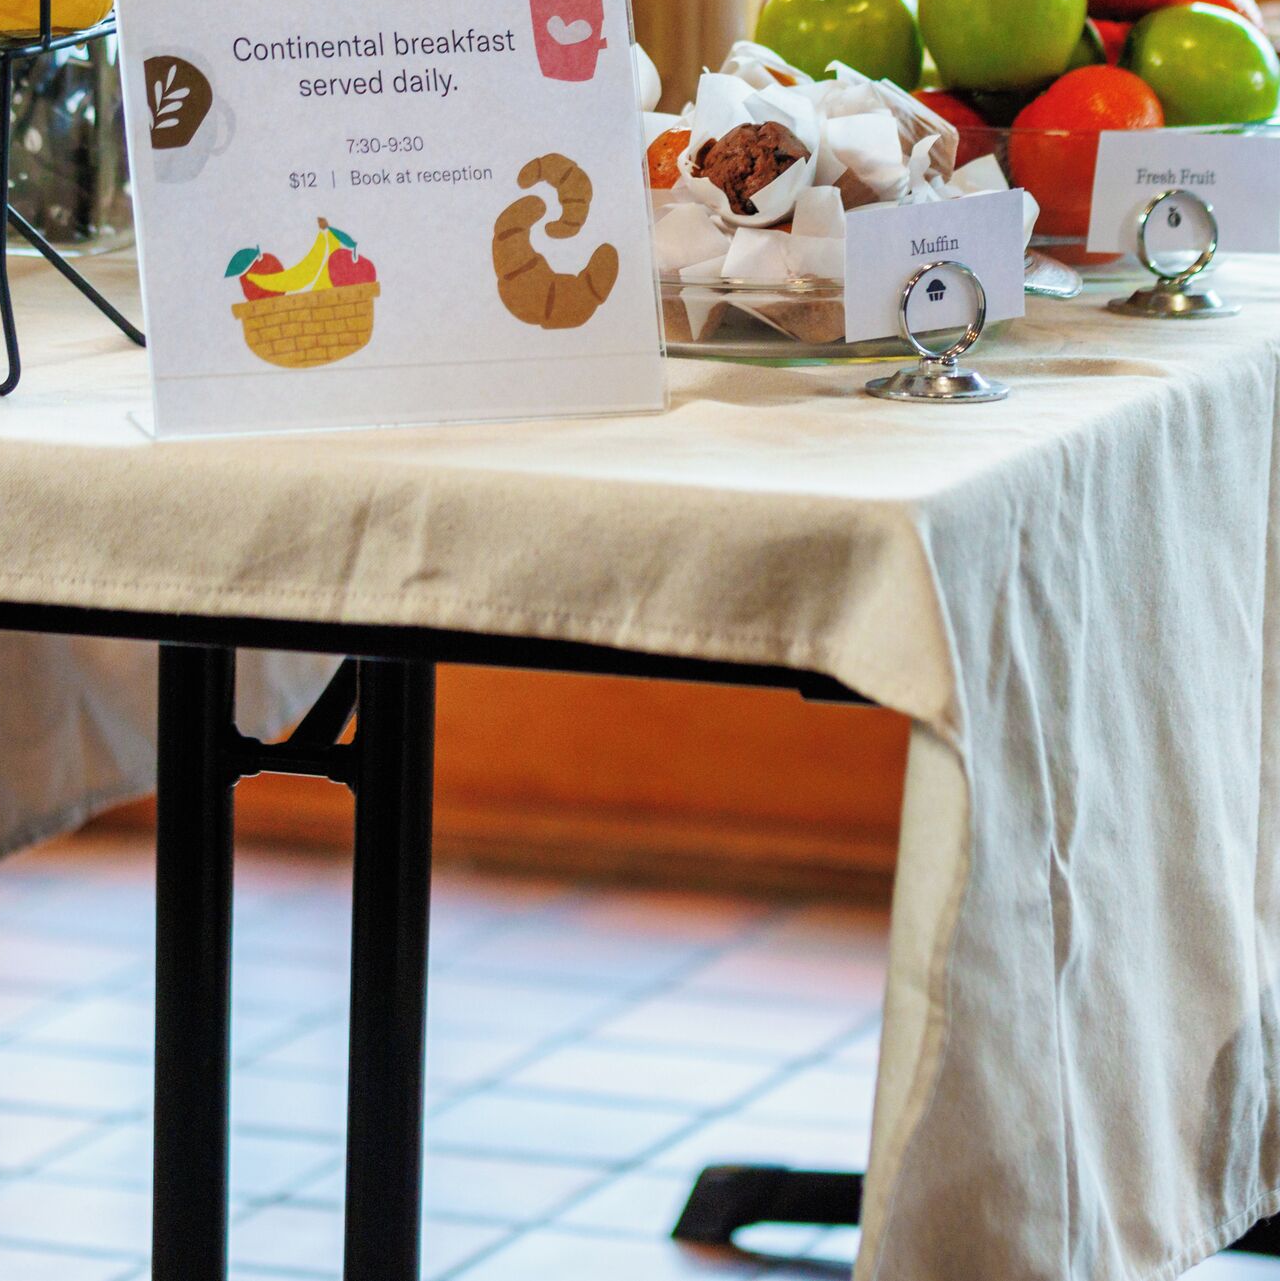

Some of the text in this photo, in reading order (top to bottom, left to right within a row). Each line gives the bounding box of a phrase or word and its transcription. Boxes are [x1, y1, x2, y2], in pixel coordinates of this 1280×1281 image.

[232, 27, 516, 63] Continental breakfast
[298, 67, 459, 98] served daily.
[345, 135, 424, 155] 7:30-9:30
[288, 171, 318, 189] $12
[350, 168, 391, 186] Book
[395, 169, 412, 184] at
[416, 166, 493, 185] reception
[1136, 167, 1216, 186] Fresh Fruit
[910, 235, 960, 257] Muffin
